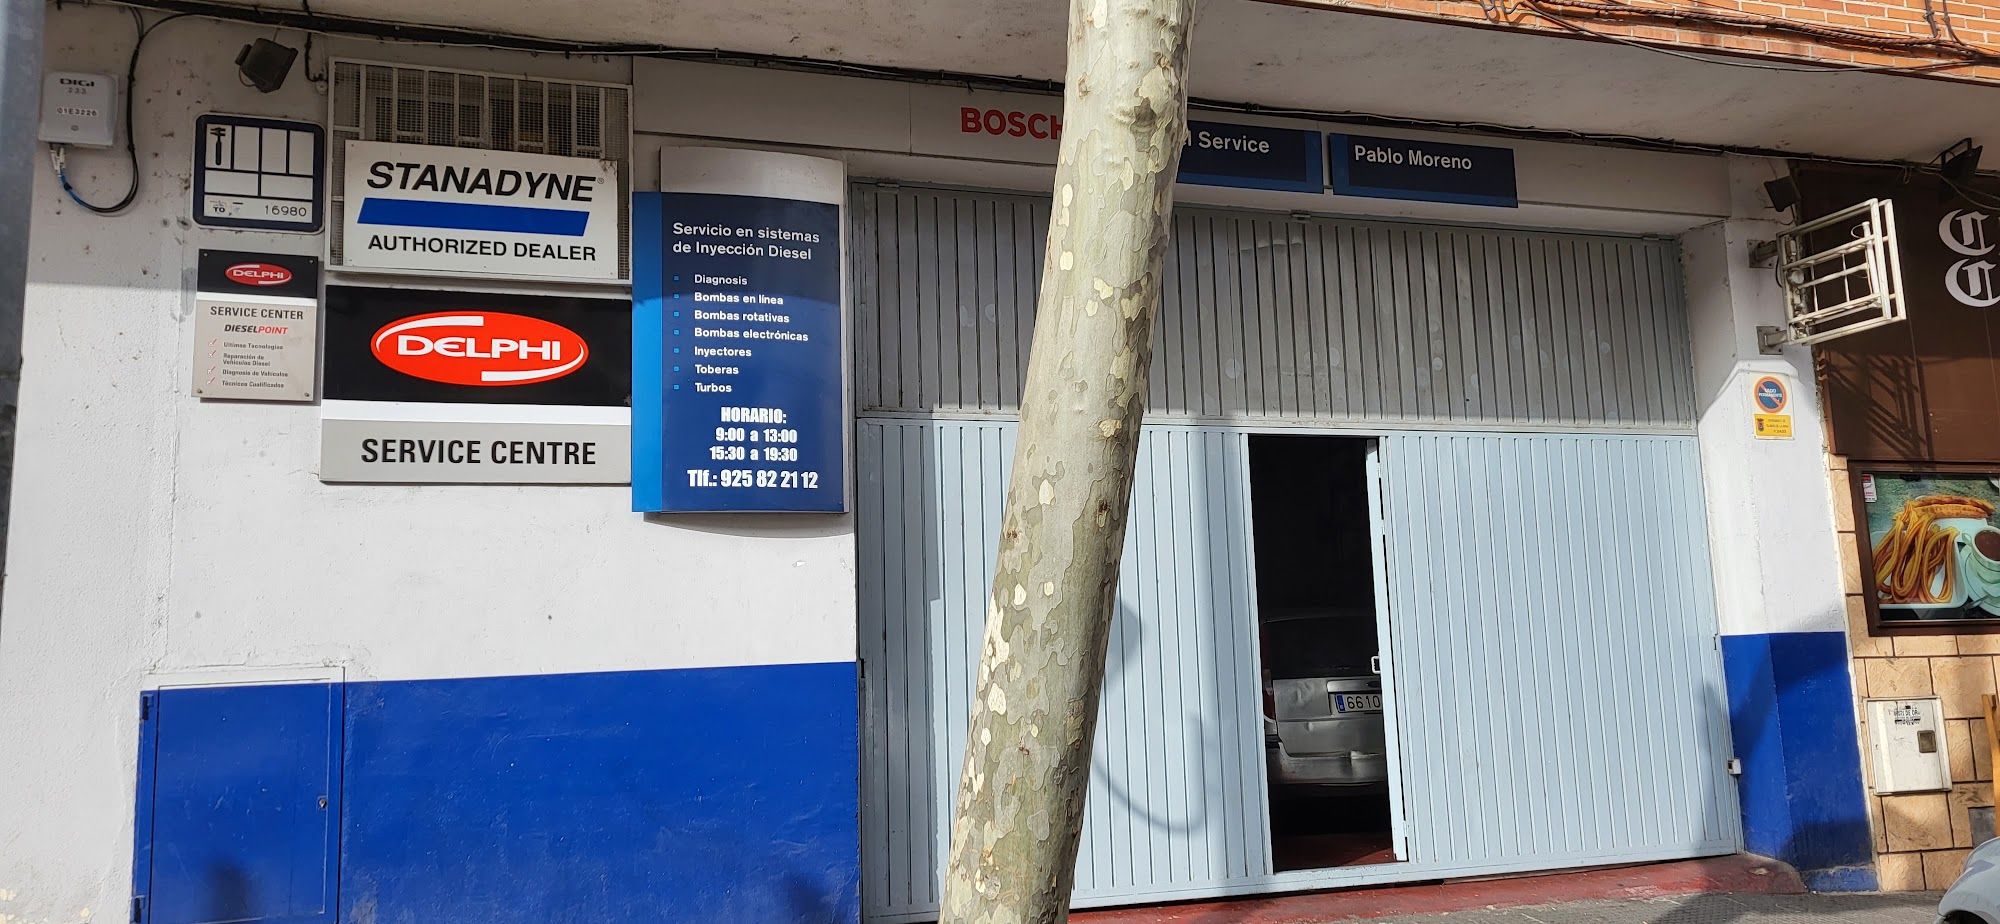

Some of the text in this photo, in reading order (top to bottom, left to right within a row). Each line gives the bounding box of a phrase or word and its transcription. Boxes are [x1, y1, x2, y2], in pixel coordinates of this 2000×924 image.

[60, 78, 95, 87] DIGI
[1198, 130, 1270, 153] Service
[1354, 144, 1473, 170] Pablo Moreno
[367, 161, 596, 202] STANADYNE
[264, 204, 307, 217] 16980
[673, 222, 820, 243] Servicio en sistemas
[368, 234, 597, 262] AUTHORIZED DEALER
[673, 241, 812, 260] de Inyección Diesel
[232, 269, 284, 279] DELPHI
[694, 274, 748, 285] Diagnosis
[694, 292, 784, 305] Bombas en línea
[210, 306, 304, 320] SERVICE CENTER
[694, 310, 790, 323] Bombas rotativas
[694, 328, 809, 342] Bombas electrónicas
[397, 334, 561, 361] DELPHI
[694, 347, 752, 358] Inyectores
[695, 365, 739, 375] Toberas
[695, 383, 732, 393] Turbos
[721, 407, 787, 424] HORARIO:
[716, 428, 798, 443] 9:00 a 13:00
[361, 438, 597, 466] SERVICE CENTRE
[709, 446, 798, 462] 15:30 a 19:30
[687, 470, 818, 489] Tlf.: 925 82 21 12
[1347, 695, 1380, 709] 6610
